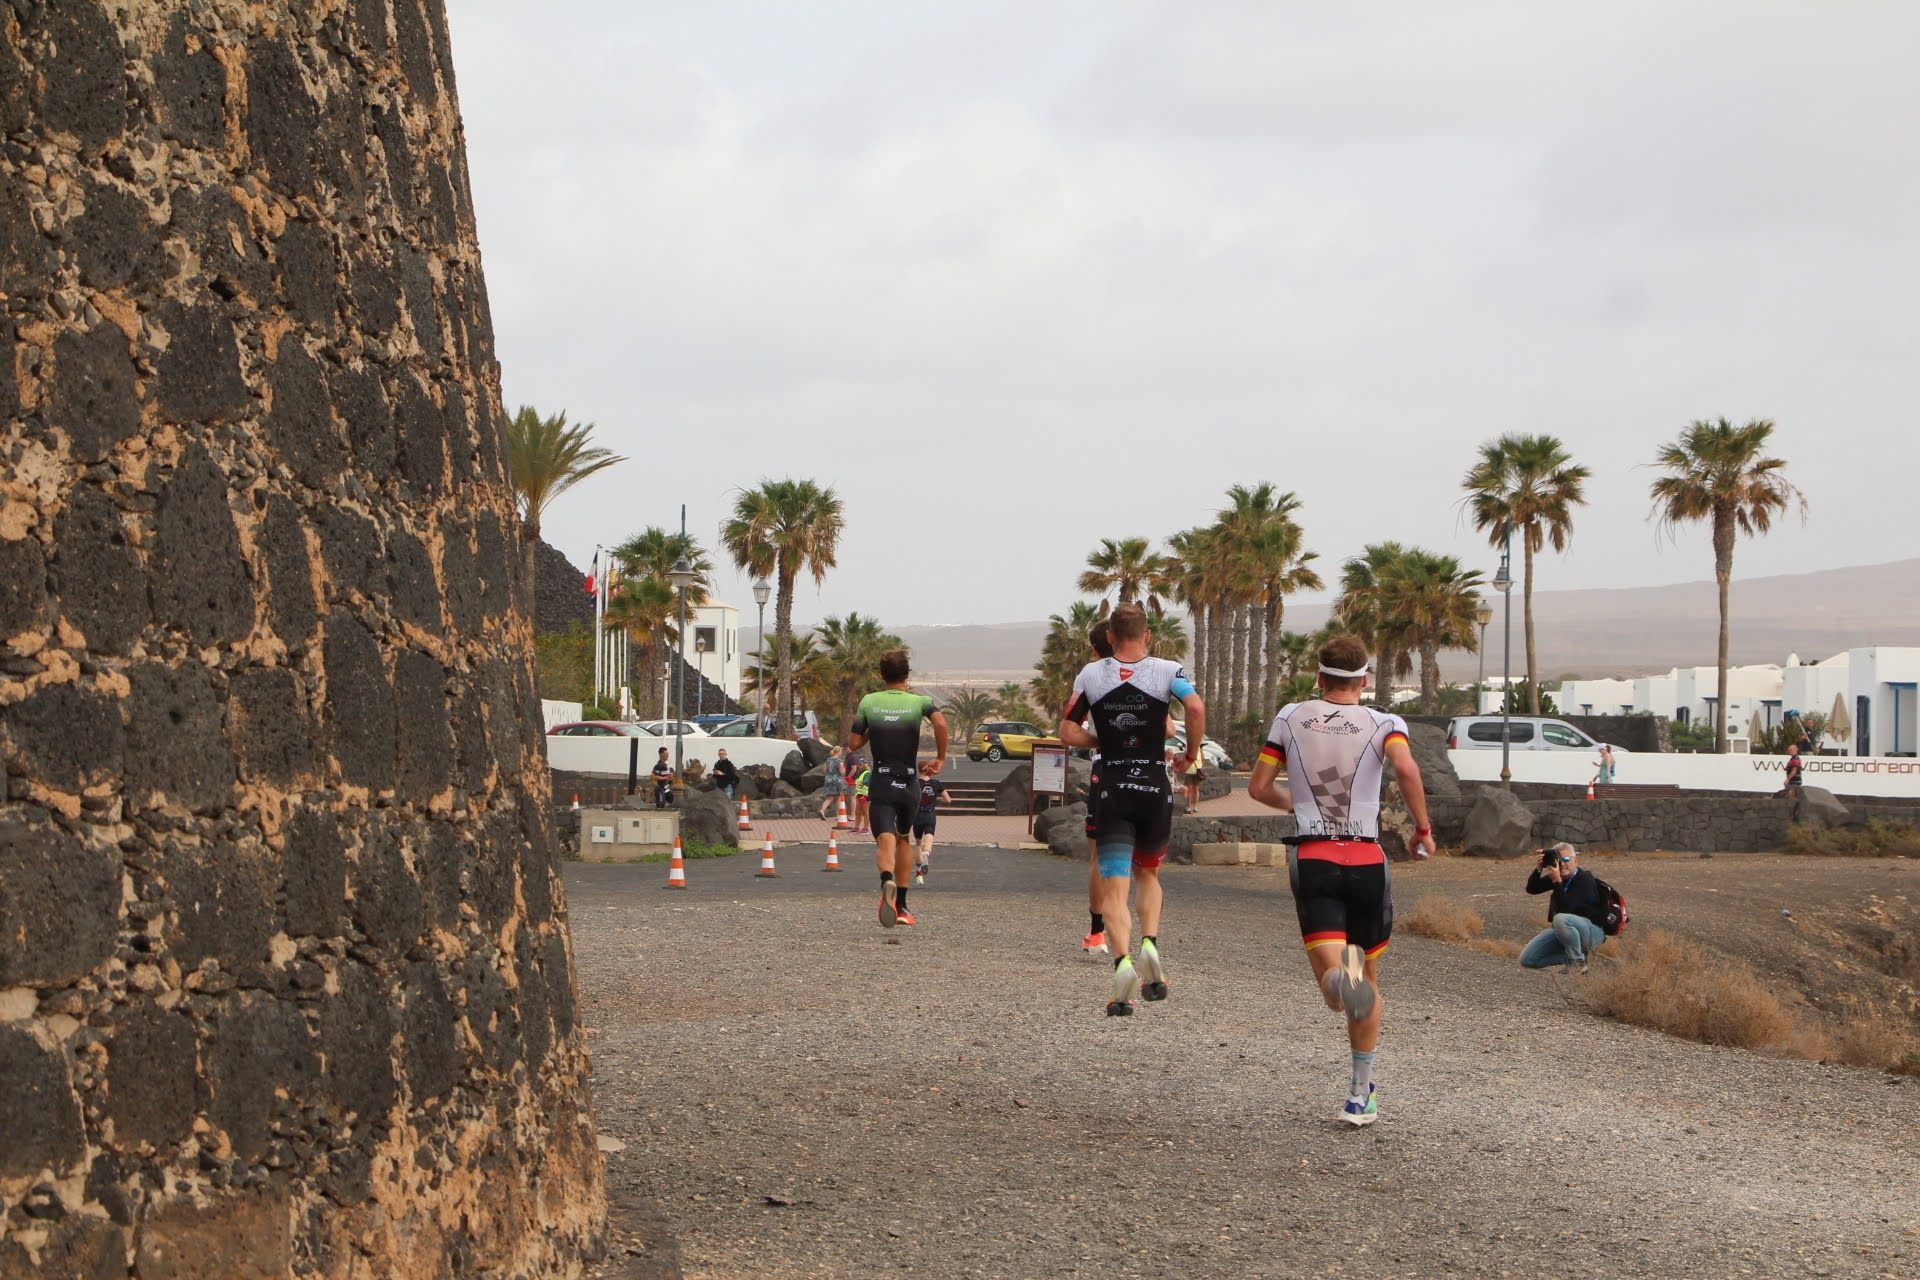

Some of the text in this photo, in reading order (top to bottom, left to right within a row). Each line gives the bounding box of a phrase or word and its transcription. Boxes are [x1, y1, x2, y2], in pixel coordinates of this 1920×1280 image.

[1103, 702, 1148, 712] Veldeman
[1116, 783, 1161, 794] TREK
[1309, 819, 1363, 836] HOFFMANN
